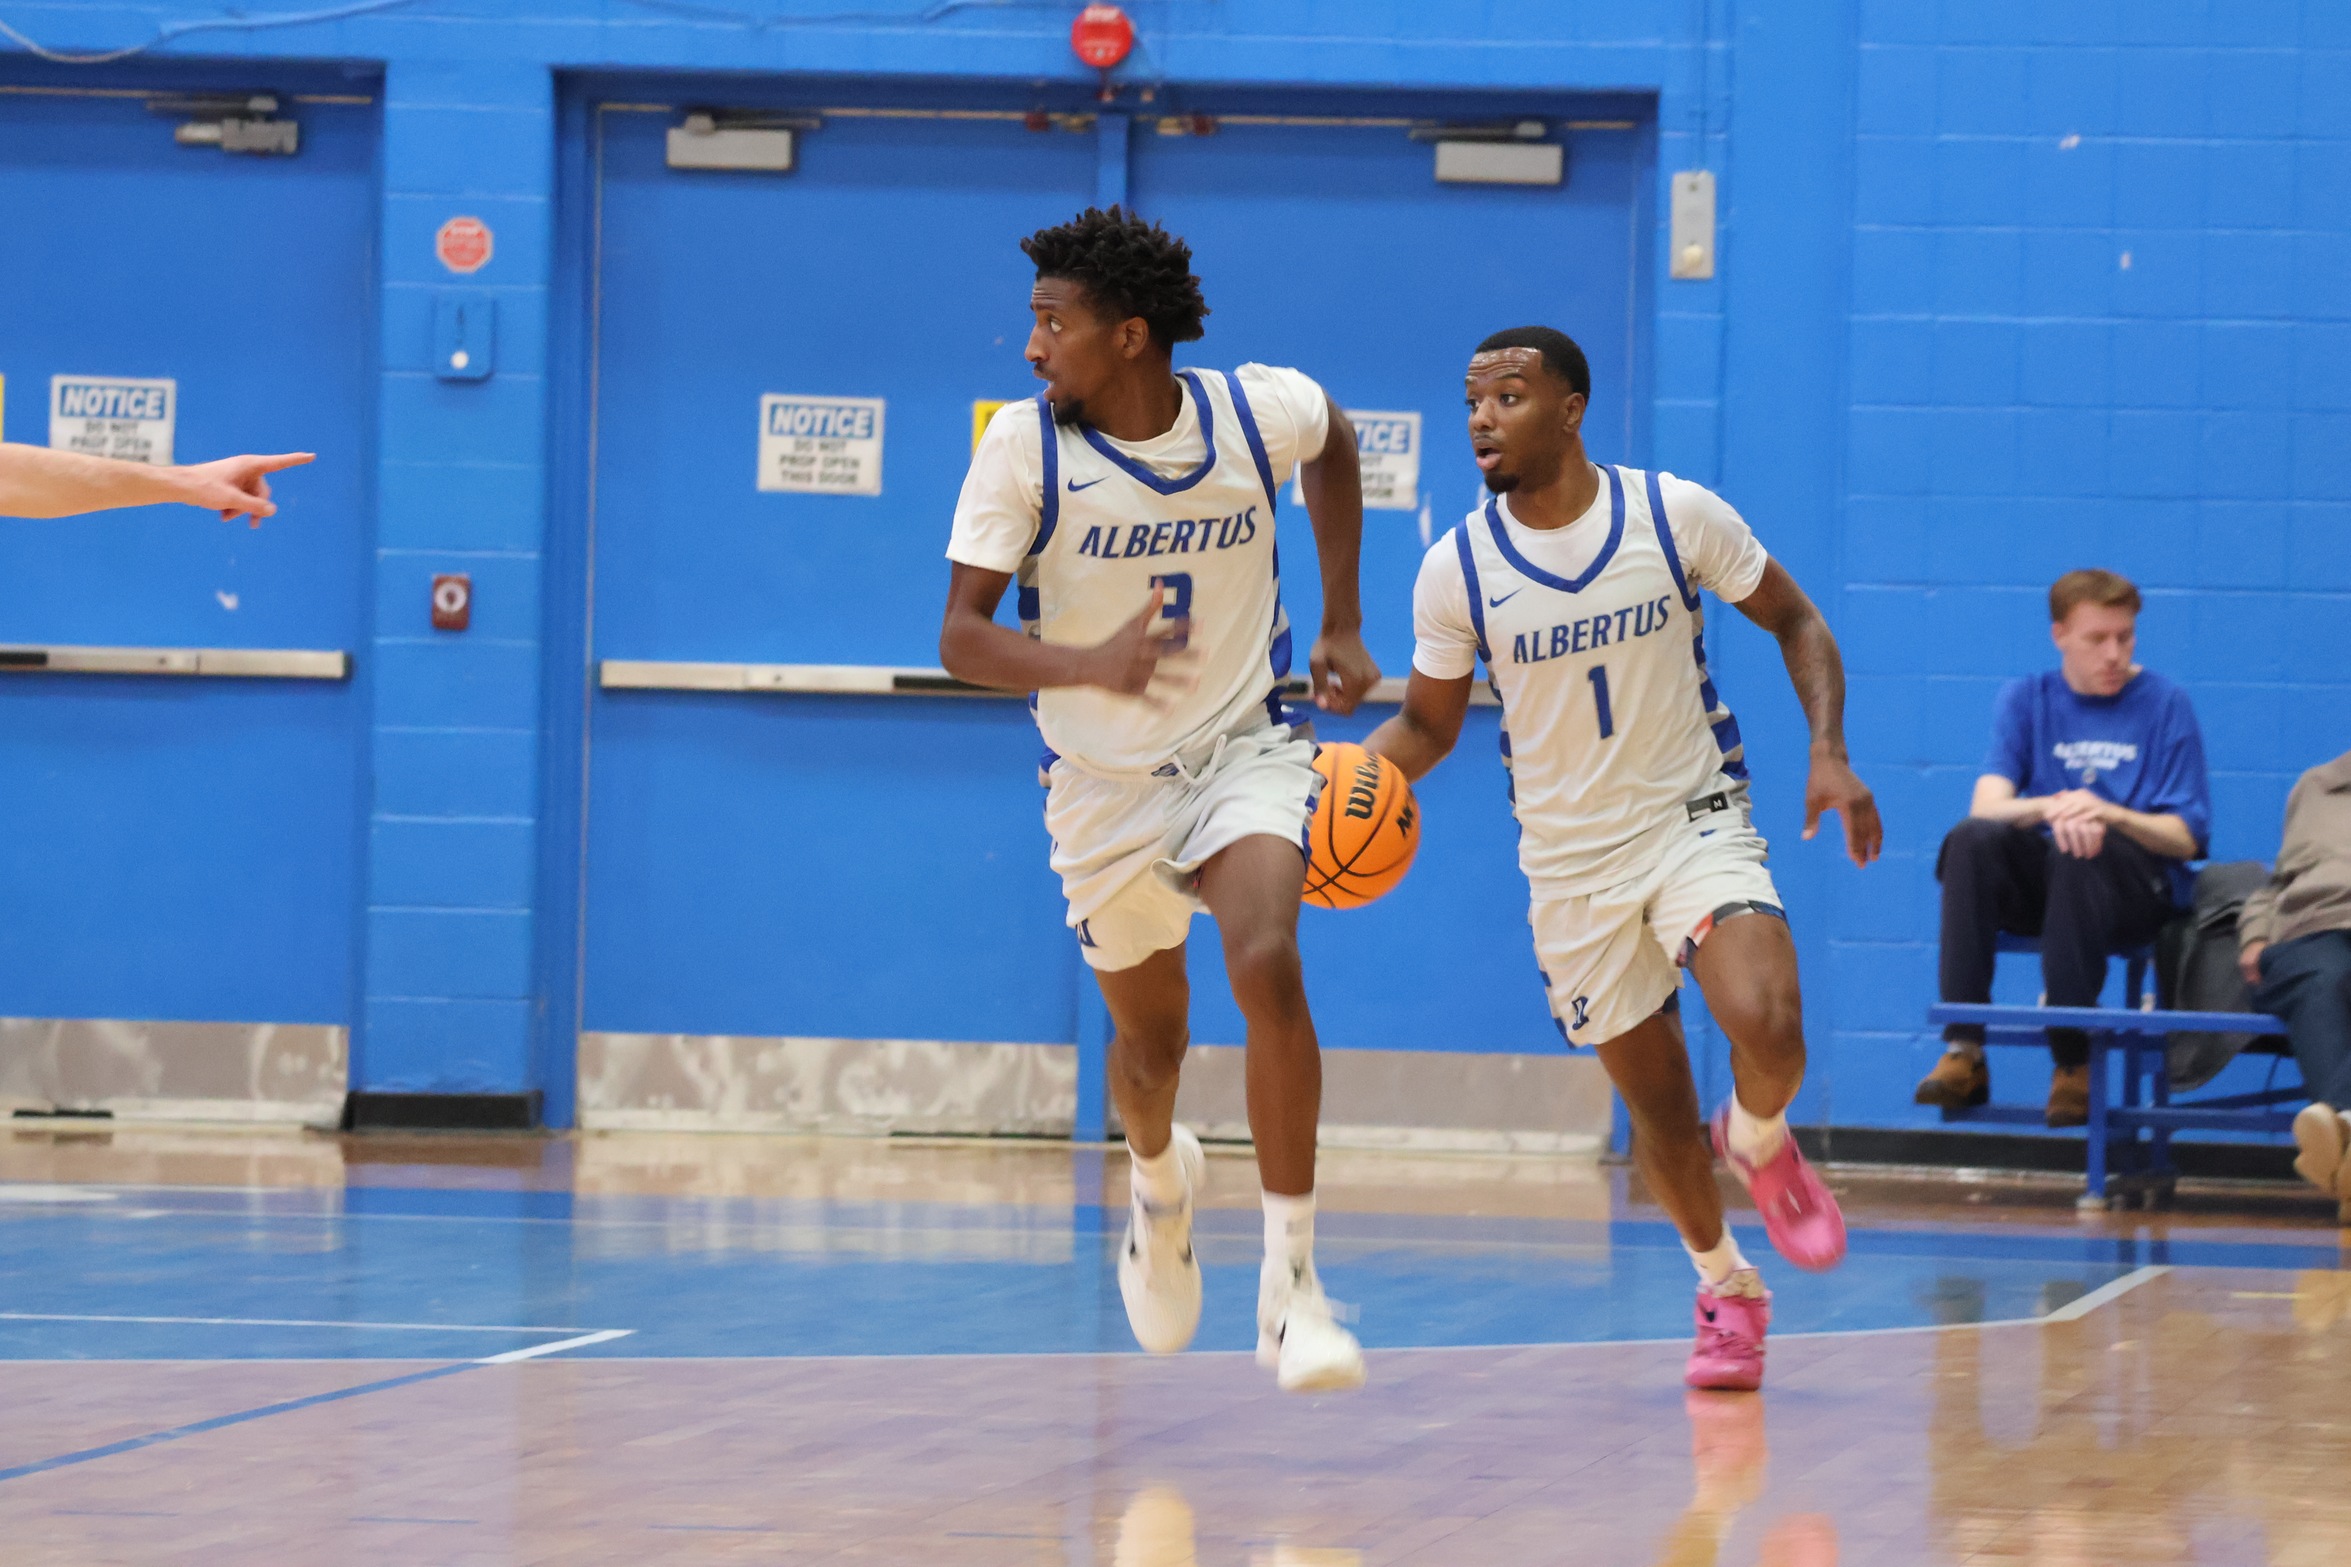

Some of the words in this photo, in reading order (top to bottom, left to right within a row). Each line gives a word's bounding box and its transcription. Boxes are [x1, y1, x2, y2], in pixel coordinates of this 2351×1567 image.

[63, 386, 163, 418] NOTICE
[772, 406, 871, 437] NOTICE
[1078, 505, 1256, 558] ALBERTUS
[1149, 572, 1193, 656] 3
[1513, 594, 1671, 663] ALBERTUS
[1587, 665, 1614, 739] 1
